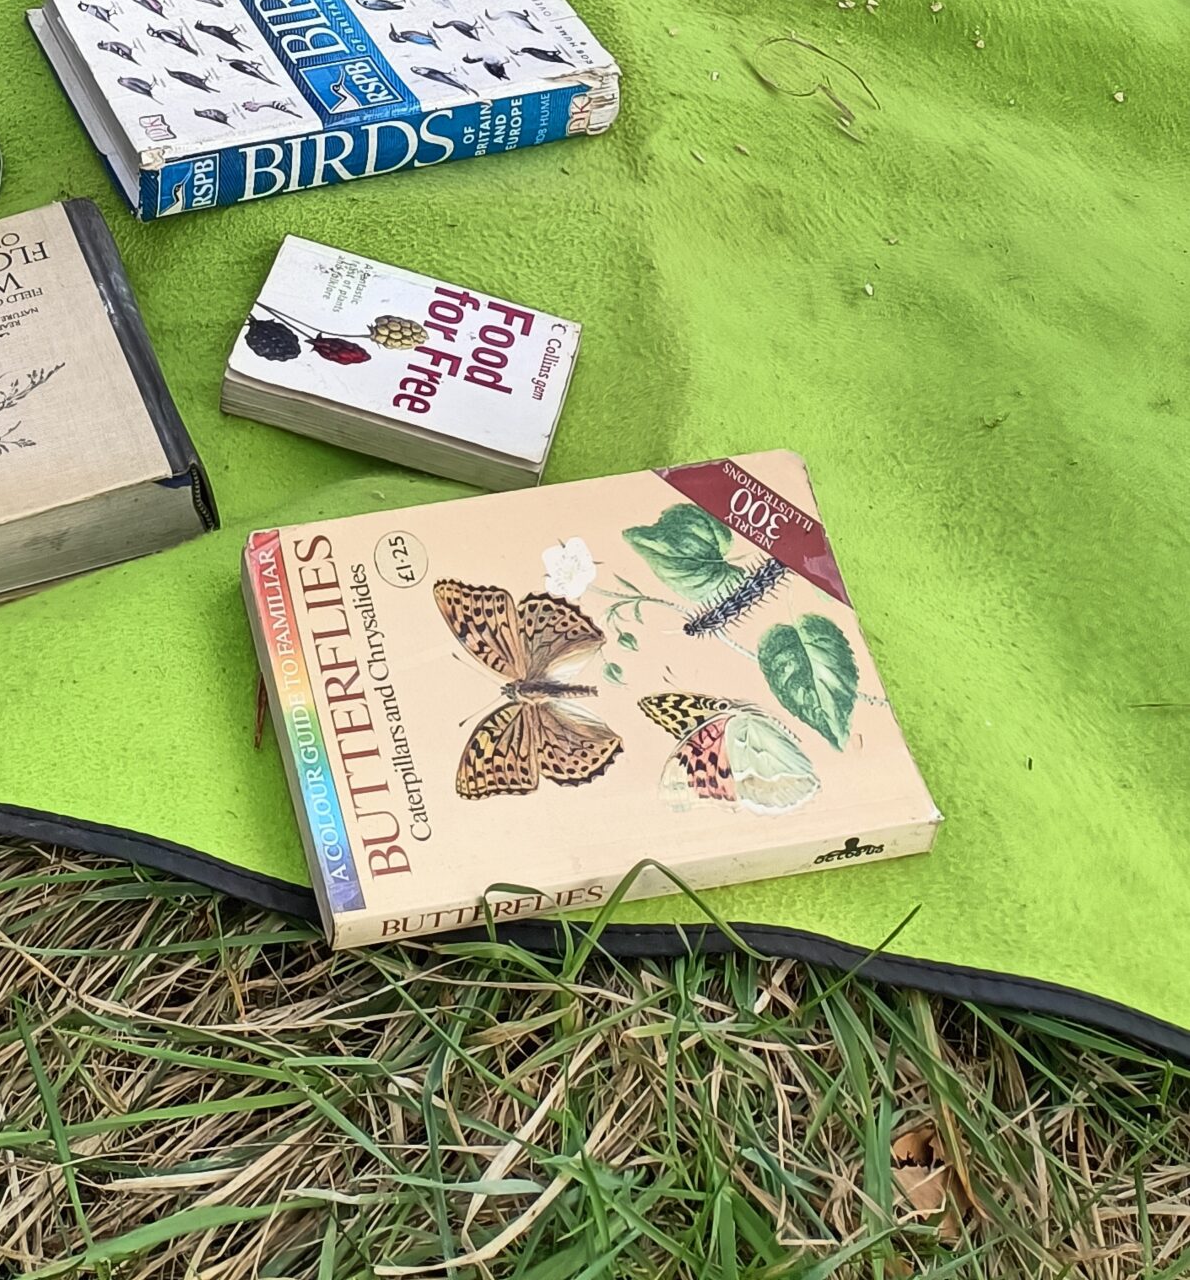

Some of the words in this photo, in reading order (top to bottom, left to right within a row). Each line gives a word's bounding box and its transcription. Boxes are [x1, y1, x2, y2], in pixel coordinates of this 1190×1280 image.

[351, 39, 368, 52] OF
[554, 25, 578, 48] HUME
[576, 49, 594, 65] ROB
[344, 61, 394, 104] RSPB
[474, 100, 494, 157] BRITAIN
[493, 114, 507, 144] AND
[505, 97, 523, 151] EUROPE
[540, 93, 551, 127] HUME
[237, 109, 455, 202] BIRDS
[463, 125, 476, 145] OF
[192, 157, 215, 209] RSPB
[6, 287, 44, 304] FIELD
[332, 289, 349, 313] plants
[342, 279, 352, 290] of
[1, 307, 40, 321] NATURE
[421, 286, 481, 344] for
[463, 301, 536, 395] Food
[539, 338, 562, 380] Collins
[392, 345, 463, 414] Free
[531, 377, 547, 401] gem
[722, 462, 814, 533] ILLUSTRATIONS
[730, 488, 789, 540] 300
[724, 512, 774, 550] NEARLY
[258, 548, 296, 655] FAMILIAR
[349, 563, 389, 682] Chrysalides
[278, 657, 300, 692] TO
[293, 534, 413, 881] BUTTERFLIES
[374, 682, 402, 723] and
[288, 694, 320, 767] GUIDE
[390, 724, 432, 842] Caterpillars
[306, 768, 345, 861] COLOUR
[332, 864, 350, 882] A
[381, 885, 605, 937] BUTTERFLIES
